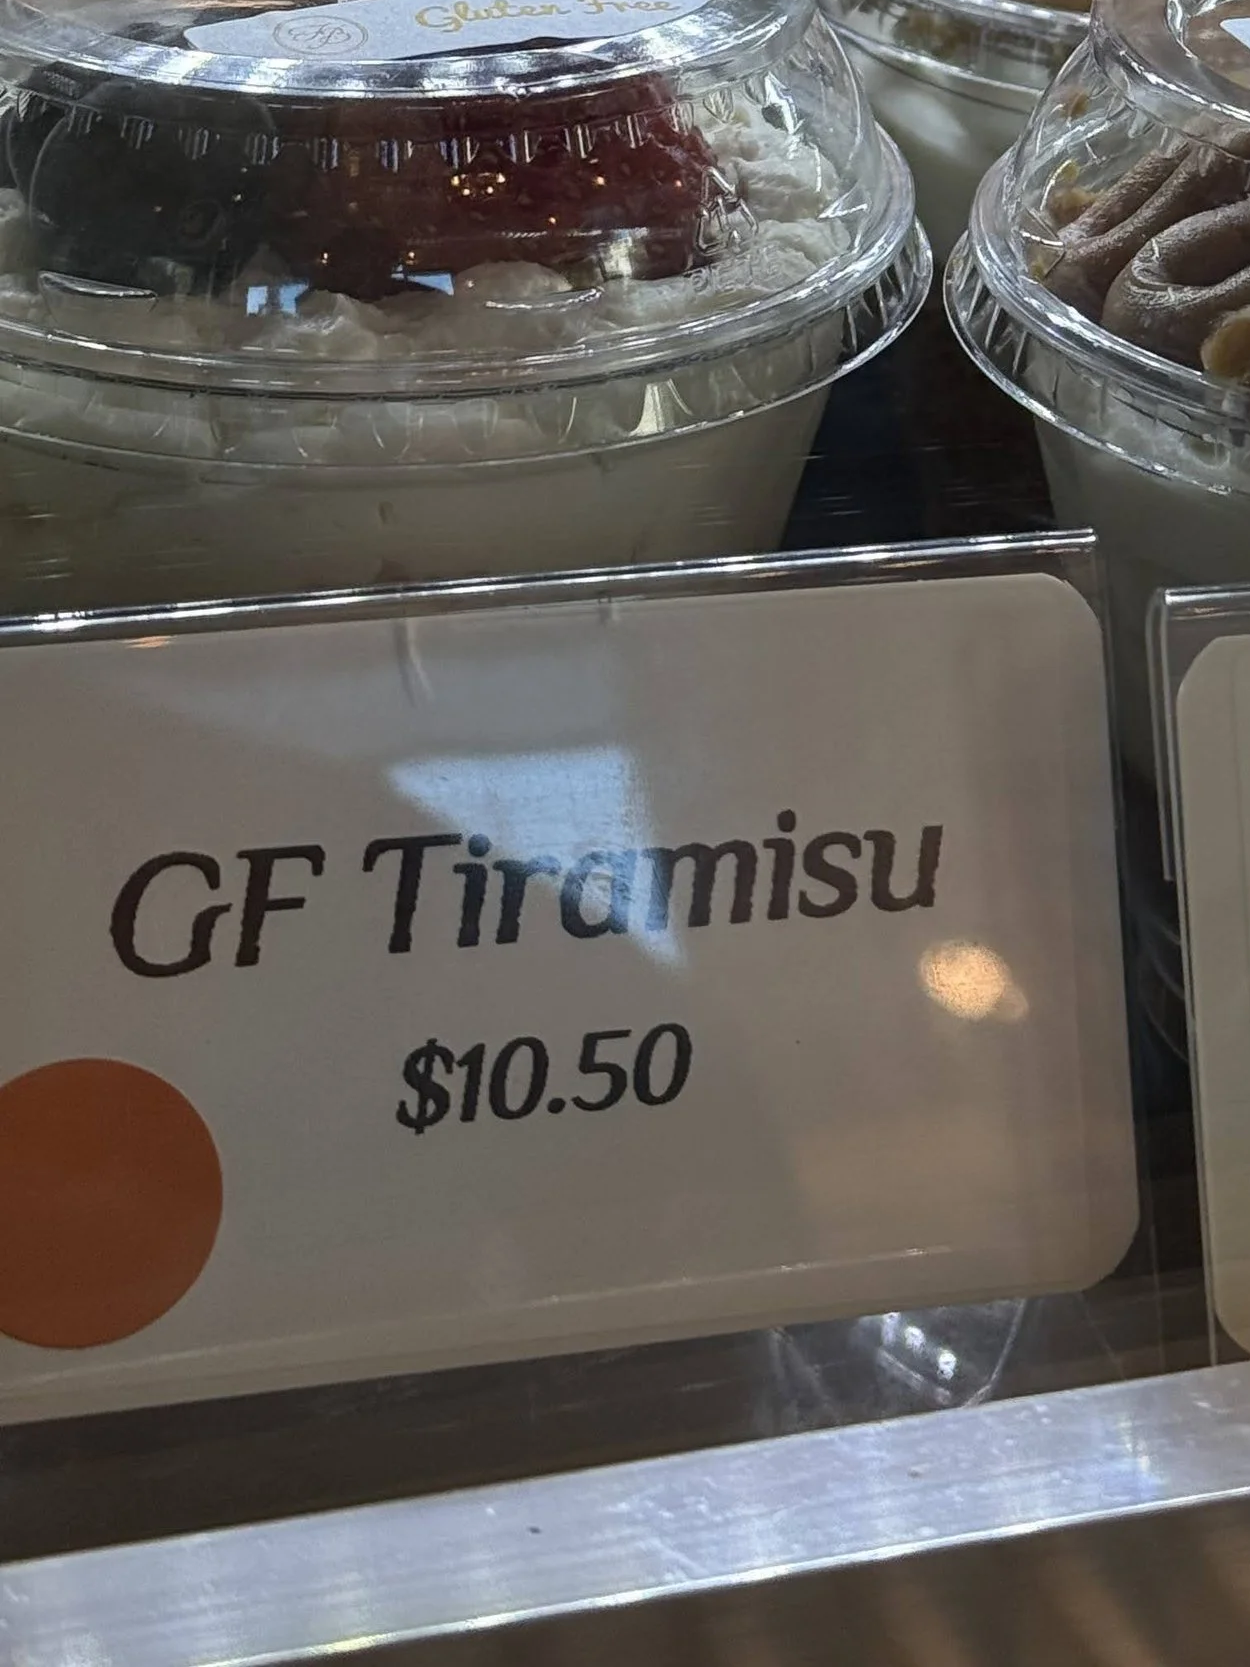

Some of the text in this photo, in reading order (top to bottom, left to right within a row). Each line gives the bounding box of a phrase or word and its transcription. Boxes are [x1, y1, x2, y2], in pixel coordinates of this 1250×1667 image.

[109, 808, 943, 979] GF Tiramisu
[395, 1023, 693, 1136] $10.50
